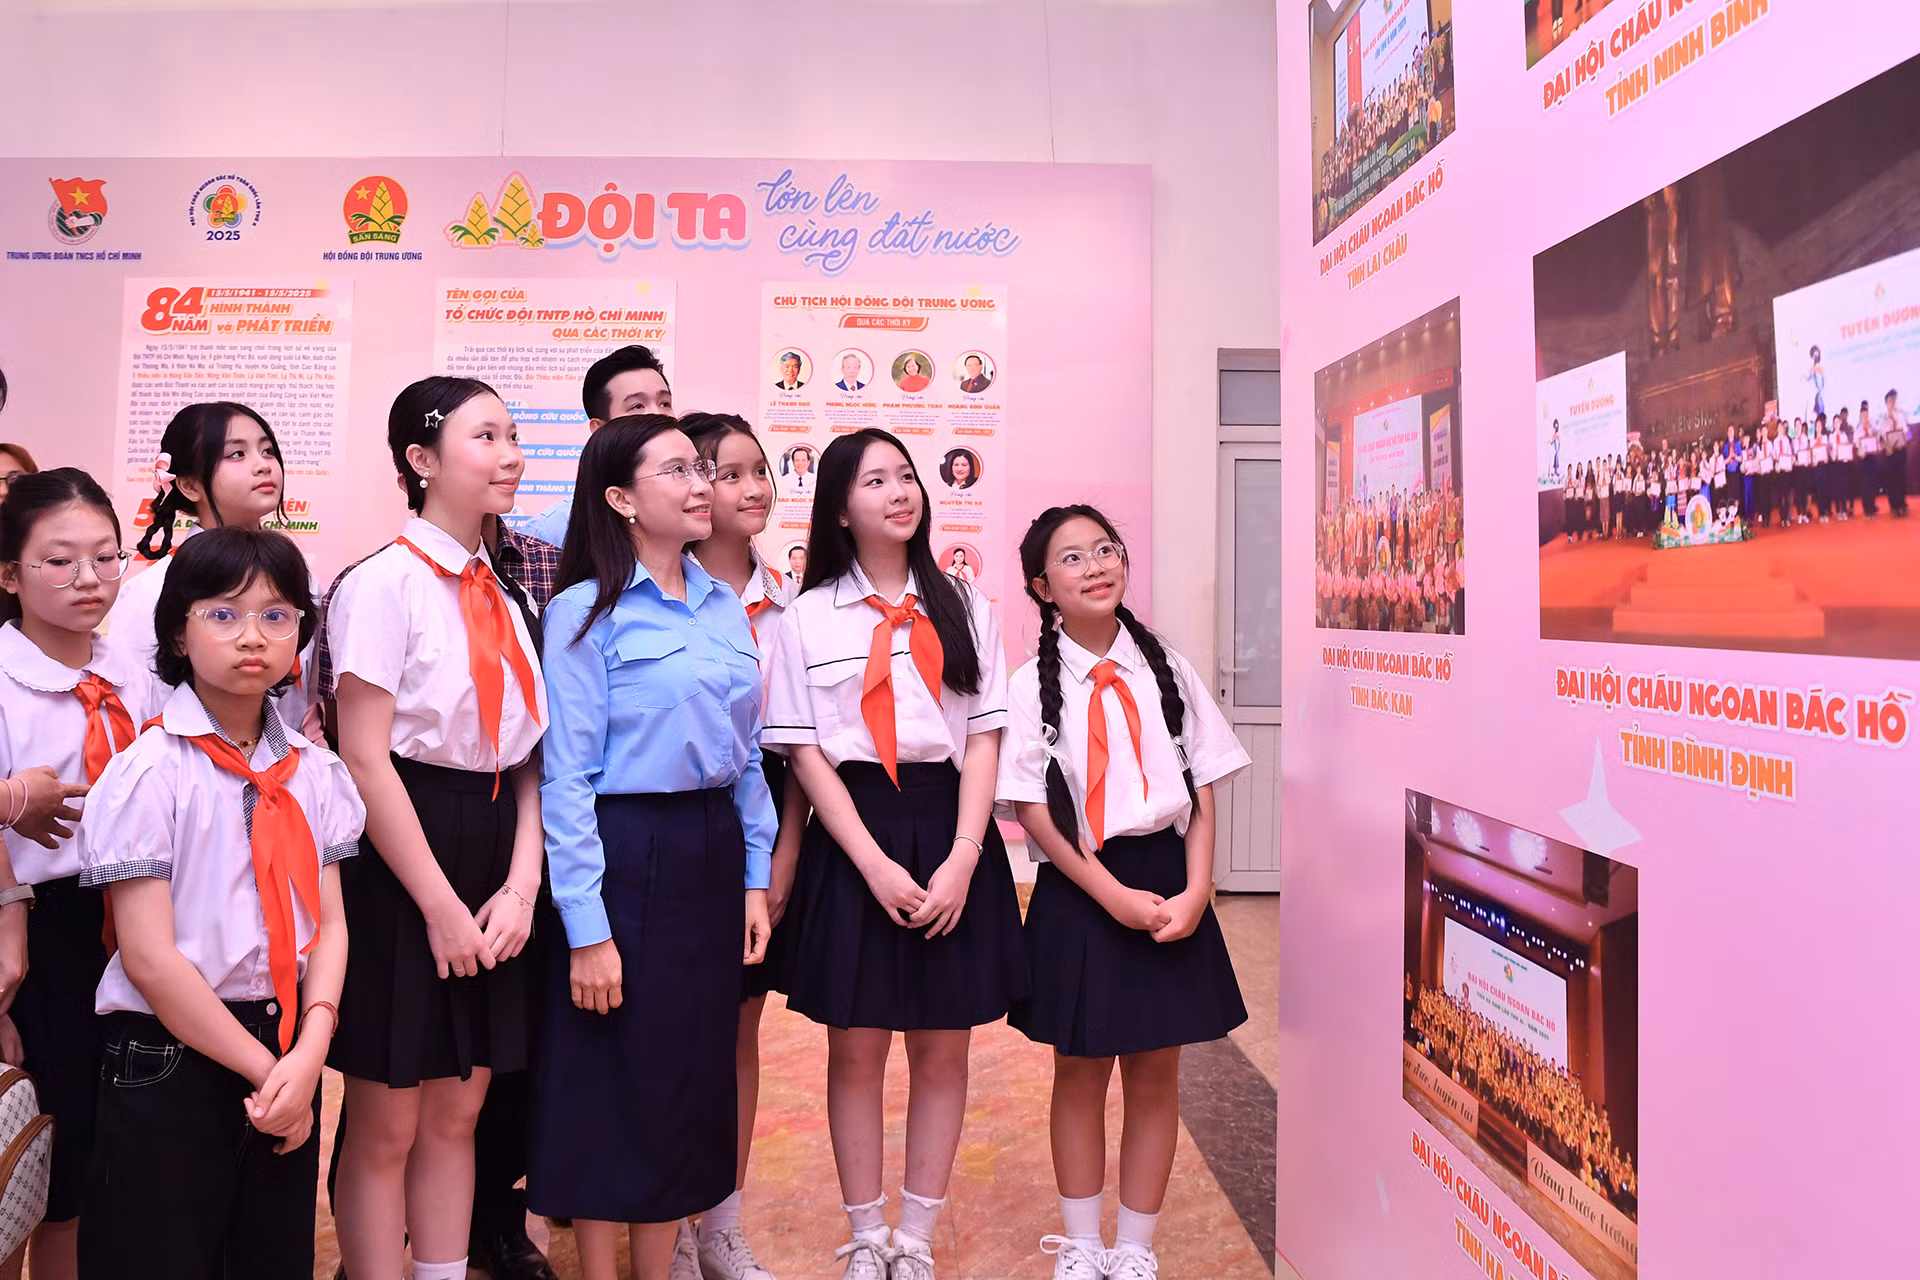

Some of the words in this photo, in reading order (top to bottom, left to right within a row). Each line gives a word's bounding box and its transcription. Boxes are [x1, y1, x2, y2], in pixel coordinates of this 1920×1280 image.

[1543, 67, 1571, 110] ĐẠI
[1575, 40, 1605, 85] HỘI
[1610, 1, 1662, 58] CHÁU
[1605, 64, 1649, 116] TỈNH
[1654, 25, 1704, 85] NINH
[1711, 0, 1768, 49] BÌNH
[757, 169, 818, 212] lớn
[824, 173, 879, 214] lên
[537, 182, 655, 253] ĐỘI
[667, 192, 746, 241] TA
[1320, 253, 1332, 276] ĐẠI
[1334, 239, 1346, 266] HỘI
[1348, 223, 1369, 254] CHÁU
[1371, 196, 1403, 238] NGOAN
[1405, 179, 1425, 213] BÁC
[1428, 158, 1445, 196] HỒ
[206, 230, 241, 241] 2025
[779, 219, 859, 272] cùng
[868, 210, 934, 252] đất
[932, 221, 1019, 251] nước
[7, 251, 30, 260] TRUNG
[76, 252, 94, 260] TNCS
[96, 250, 106, 260] HỒ
[107, 251, 120, 260] CHÍ
[122, 252, 142, 260] MINH
[323, 251, 336, 262] HỘI
[338, 250, 358, 260] ĐỒNG
[360, 251, 373, 262] ĐỘI
[375, 252, 399, 260] TRUNG
[402, 251, 422, 260] ƯƠNG
[1347, 261, 1365, 290] TỈNH
[1367, 250, 1381, 279] LAI
[1383, 232, 1408, 266] CHÂU
[210, 289, 256, 297] 15/5/1941
[264, 289, 312, 297] 15/5/2025
[446, 288, 469, 300] TÊN
[472, 290, 497, 304] GỌI
[499, 287, 525, 300] CỦA
[773, 294, 797, 306] CHỦ
[800, 297, 827, 310] TỊCH
[830, 294, 851, 310] HỘI
[854, 295, 889, 307] ĐỒNG
[892, 295, 913, 311] ĐỘI
[917, 298, 957, 308] TRUNG
[960, 298, 995, 308] ƯƠNG
[141, 286, 204, 331] 84
[210, 302, 242, 313] HÌNH
[246, 301, 291, 313] THÀNH
[445, 304, 463, 320] TỔ
[467, 307, 504, 320] CHỨC
[506, 307, 533, 324] ĐỘI
[536, 310, 570, 321] TNTP
[573, 306, 595, 321] HỒ
[599, 308, 624, 321] CHÍ
[625, 311, 664, 322] MINH
[1883, 304, 1920, 328] DƯƠN
[172, 314, 208, 331] NĂM
[217, 320, 233, 332] và
[236, 316, 282, 332] PHÁT
[284, 313, 332, 332] TRIỂN
[552, 328, 579, 339] QUA
[583, 326, 609, 339] CÁC
[611, 327, 642, 339] THỜI
[644, 327, 663, 339] KỲ
[856, 318, 870, 326] QUA
[871, 317, 885, 326] CÁC
[886, 317, 902, 326] THỜI
[512, 410, 539, 420] ĐỒNG
[540, 411, 558, 420] CỨU
[560, 411, 585, 421] QUỐC
[537, 447, 555, 456] CỨU
[556, 446, 582, 457] QUỐC
[535, 483, 565, 492] THÁNG
[287, 521, 318, 530] MINH
[1323, 647, 1335, 669] ĐẠI
[1337, 644, 1350, 671] HỘI
[1352, 647, 1374, 672] CHÁU
[1377, 652, 1409, 676] NGOAN
[1412, 653, 1432, 679] BÁC
[1435, 652, 1453, 681] HỒ
[1351, 680, 1368, 707] TỈNH
[1371, 683, 1389, 711] BẮC
[1391, 693, 1413, 719] KẠN
[1557, 669, 1585, 704] ĐẠI
[1590, 666, 1621, 709] HỘI
[1627, 674, 1682, 712] CHÁU
[1689, 682, 1778, 726] NGOAN
[1786, 688, 1847, 736] BÁC
[1857, 691, 1911, 743] HỒ
[1620, 723, 1665, 769] TỈNH
[1671, 737, 1724, 783] BÌNH
[1730, 751, 1793, 797] ĐỊNH
[1507, 995, 1530, 1016] NGOAN
[1531, 1008, 1544, 1025] BÁC
[1412, 1131, 1430, 1168] ĐẠI
[1433, 1153, 1453, 1192] HỘI
[1456, 1175, 1489, 1226] CHÁU
[1493, 1210, 1544, 1280] NGOAN
[1455, 1217, 1483, 1267] TỈNH
[1486, 1250, 1505, 1280] HÀ
